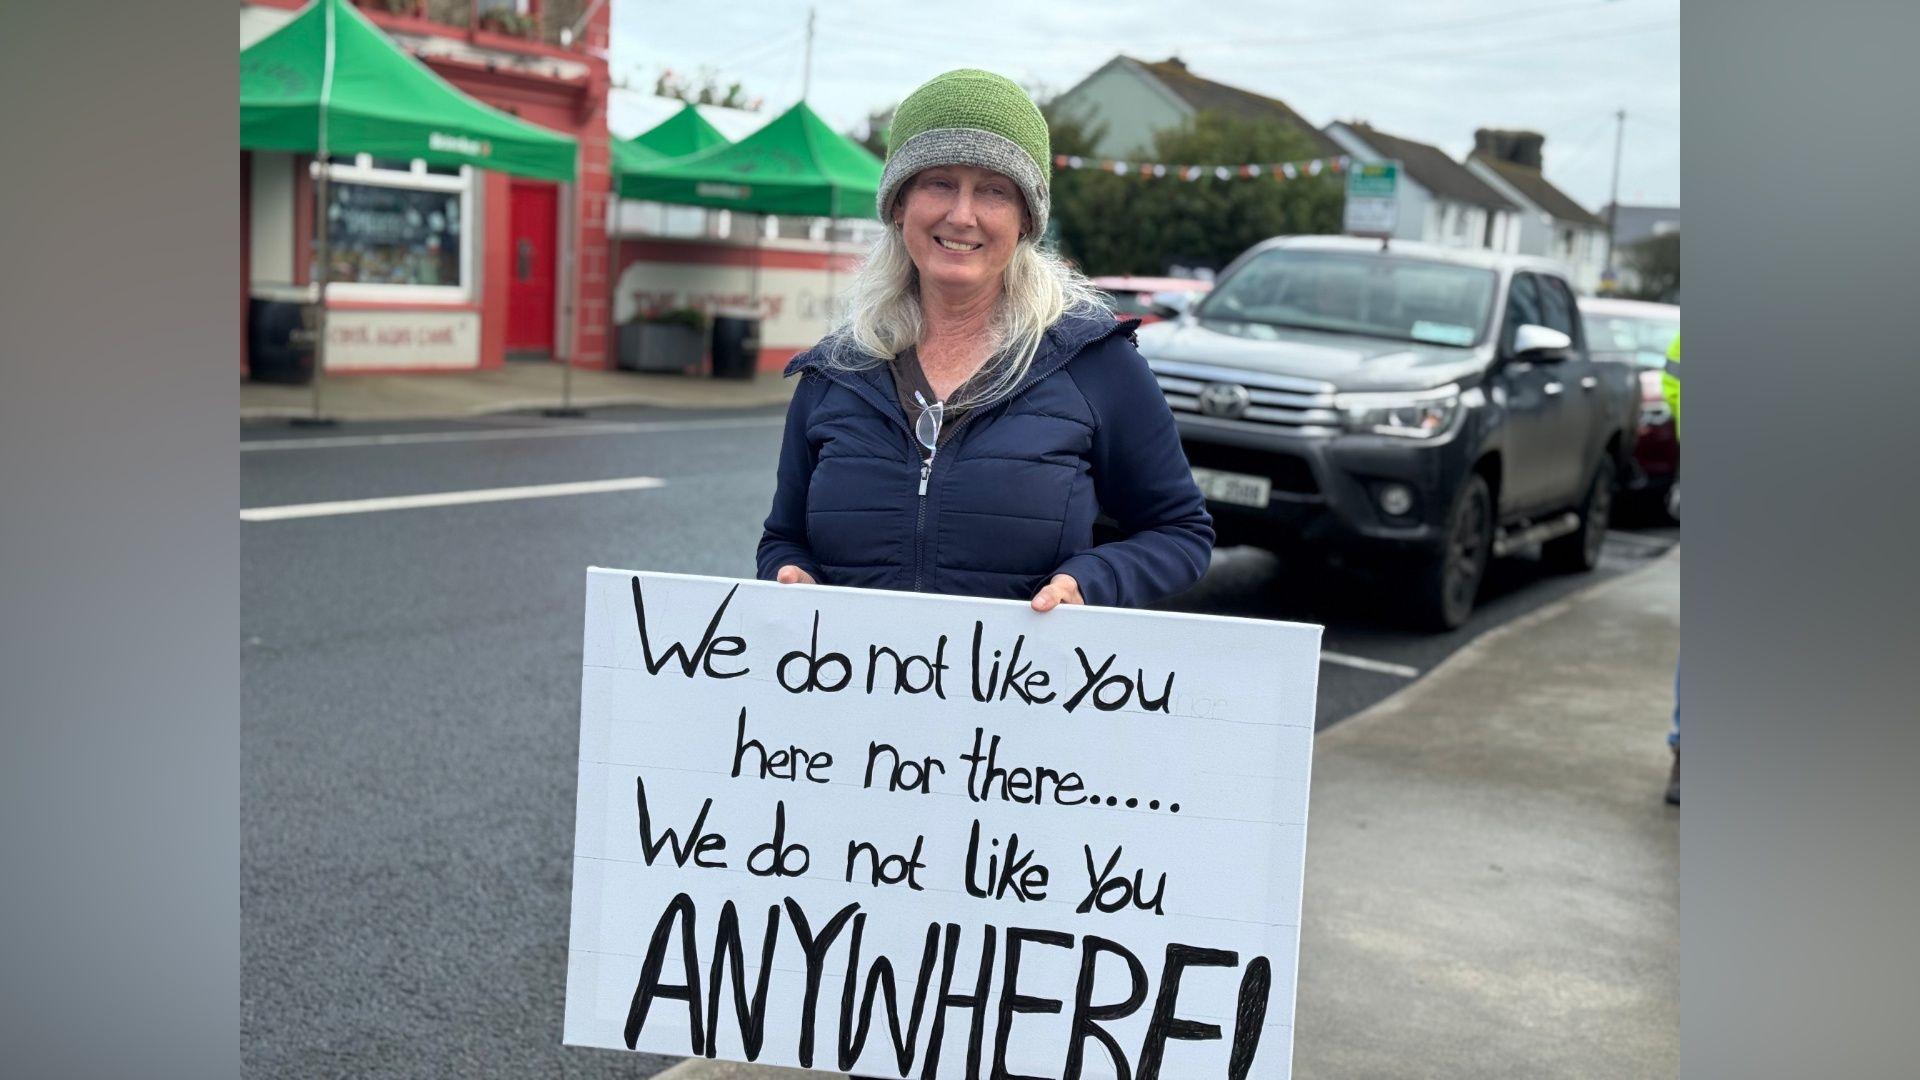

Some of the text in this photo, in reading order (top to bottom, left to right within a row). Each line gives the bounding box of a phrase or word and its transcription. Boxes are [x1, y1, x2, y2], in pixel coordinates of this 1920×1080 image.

[631, 576, 1175, 714] We do not like You
[731, 707, 834, 783] here
[864, 741, 946, 795] nor
[637, 776, 1167, 916] We do not like You
